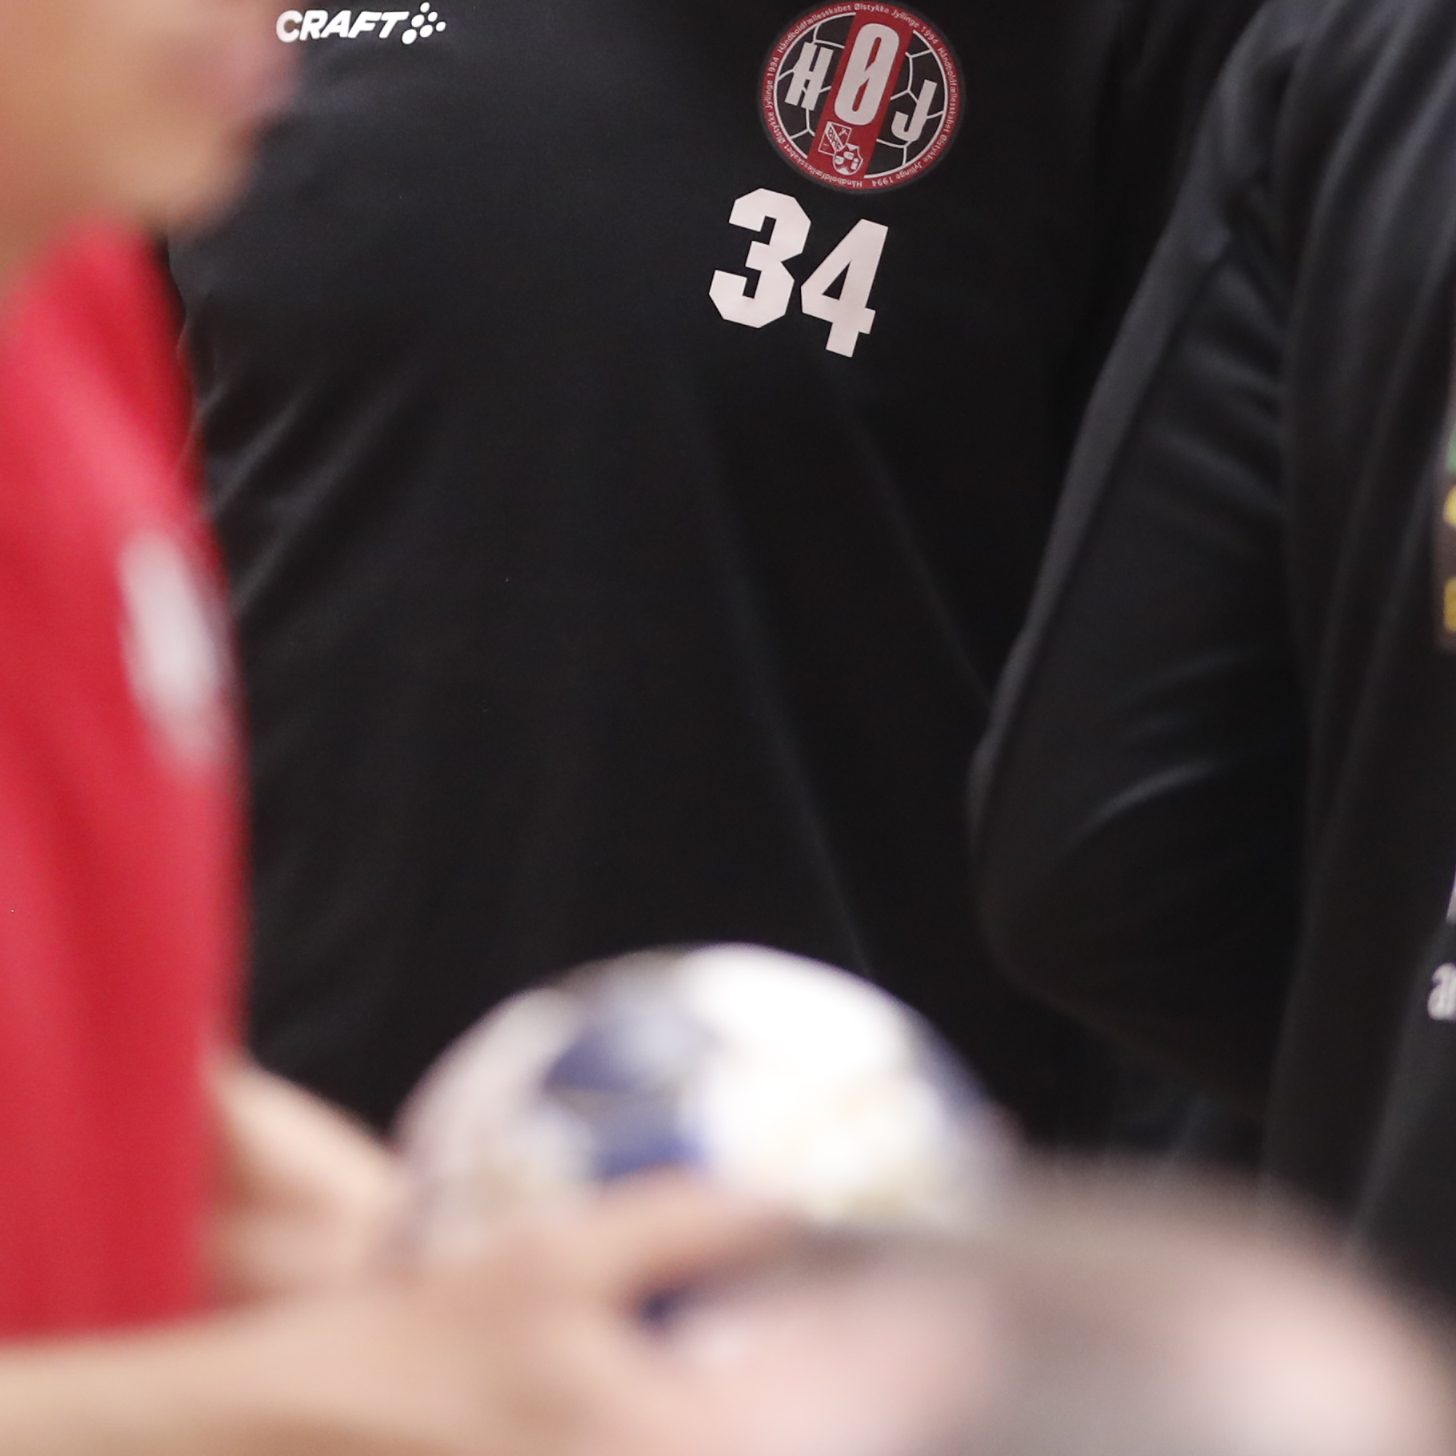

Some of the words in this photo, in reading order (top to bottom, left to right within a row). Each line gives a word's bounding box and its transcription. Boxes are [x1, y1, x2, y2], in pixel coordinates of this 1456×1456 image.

[275, 9, 410, 44] CRAFT
[921, 26, 939, 44] 1994
[708, 187, 889, 358] 34
